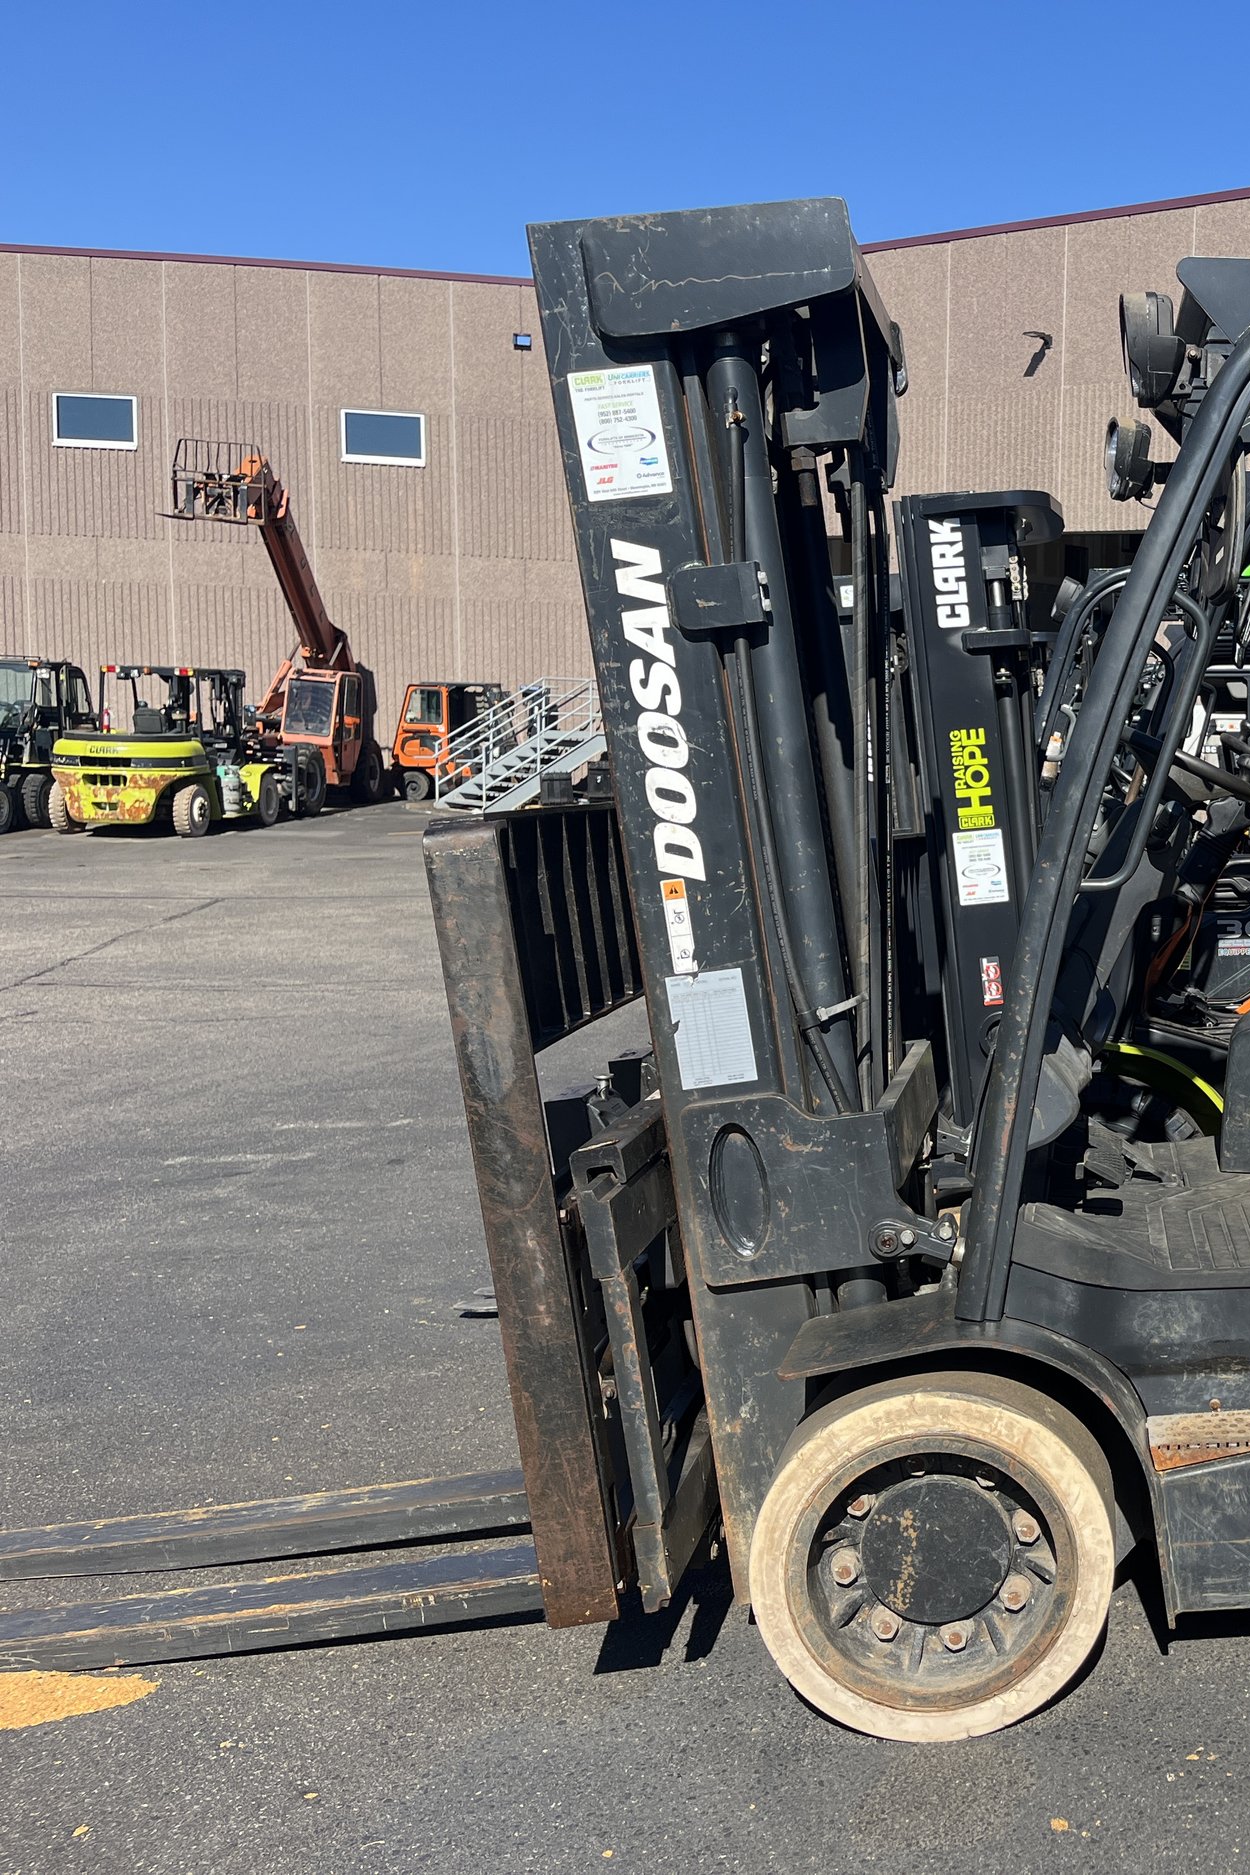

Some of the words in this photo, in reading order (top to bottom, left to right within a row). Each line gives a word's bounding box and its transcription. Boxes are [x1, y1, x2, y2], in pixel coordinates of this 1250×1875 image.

[928, 517, 970, 629] CLARK
[610, 538, 707, 882] DOOSAN
[89, 745, 120, 754] CLARK
[949, 729, 967, 789] RAISING
[955, 728, 994, 816] HOPE
[961, 816, 993, 828] CLARK
